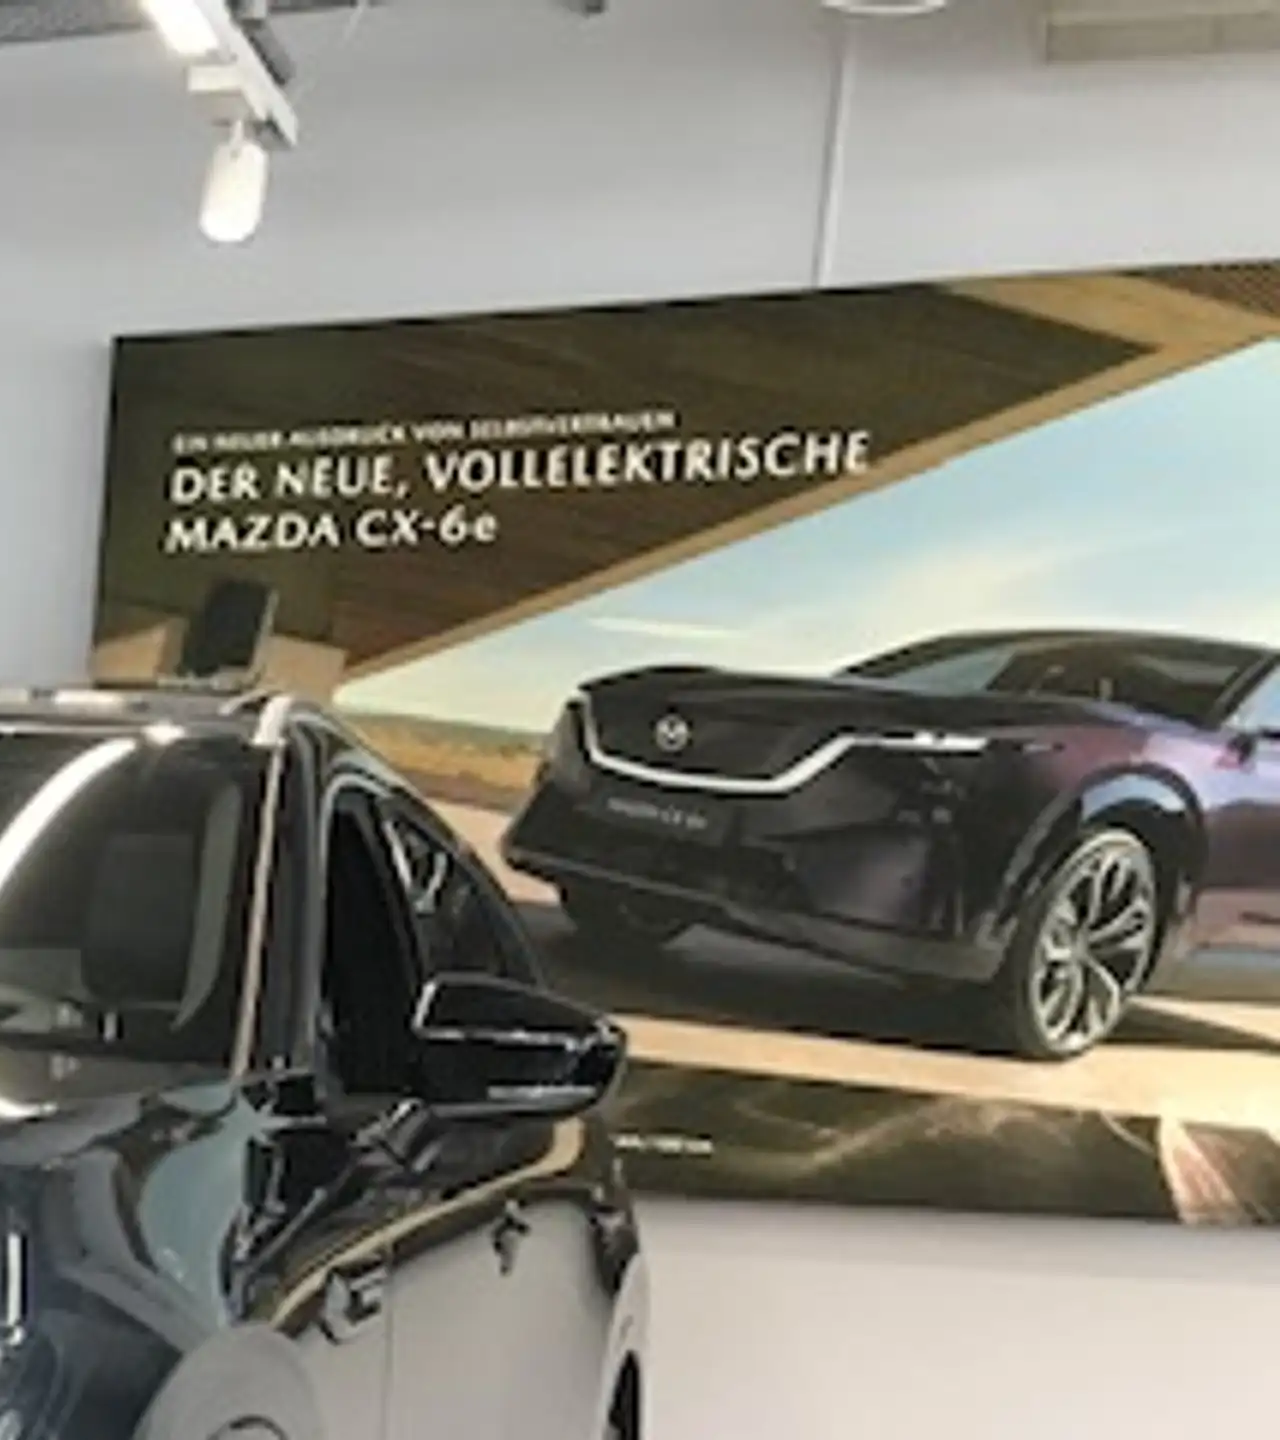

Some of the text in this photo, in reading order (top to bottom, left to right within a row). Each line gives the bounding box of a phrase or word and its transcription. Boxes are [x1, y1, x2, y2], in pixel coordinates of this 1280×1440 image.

[171, 430, 870, 504] DER NEUE, VOLLELEKTRISCHE
[164, 505, 498, 552] MAZDA CX-6e
